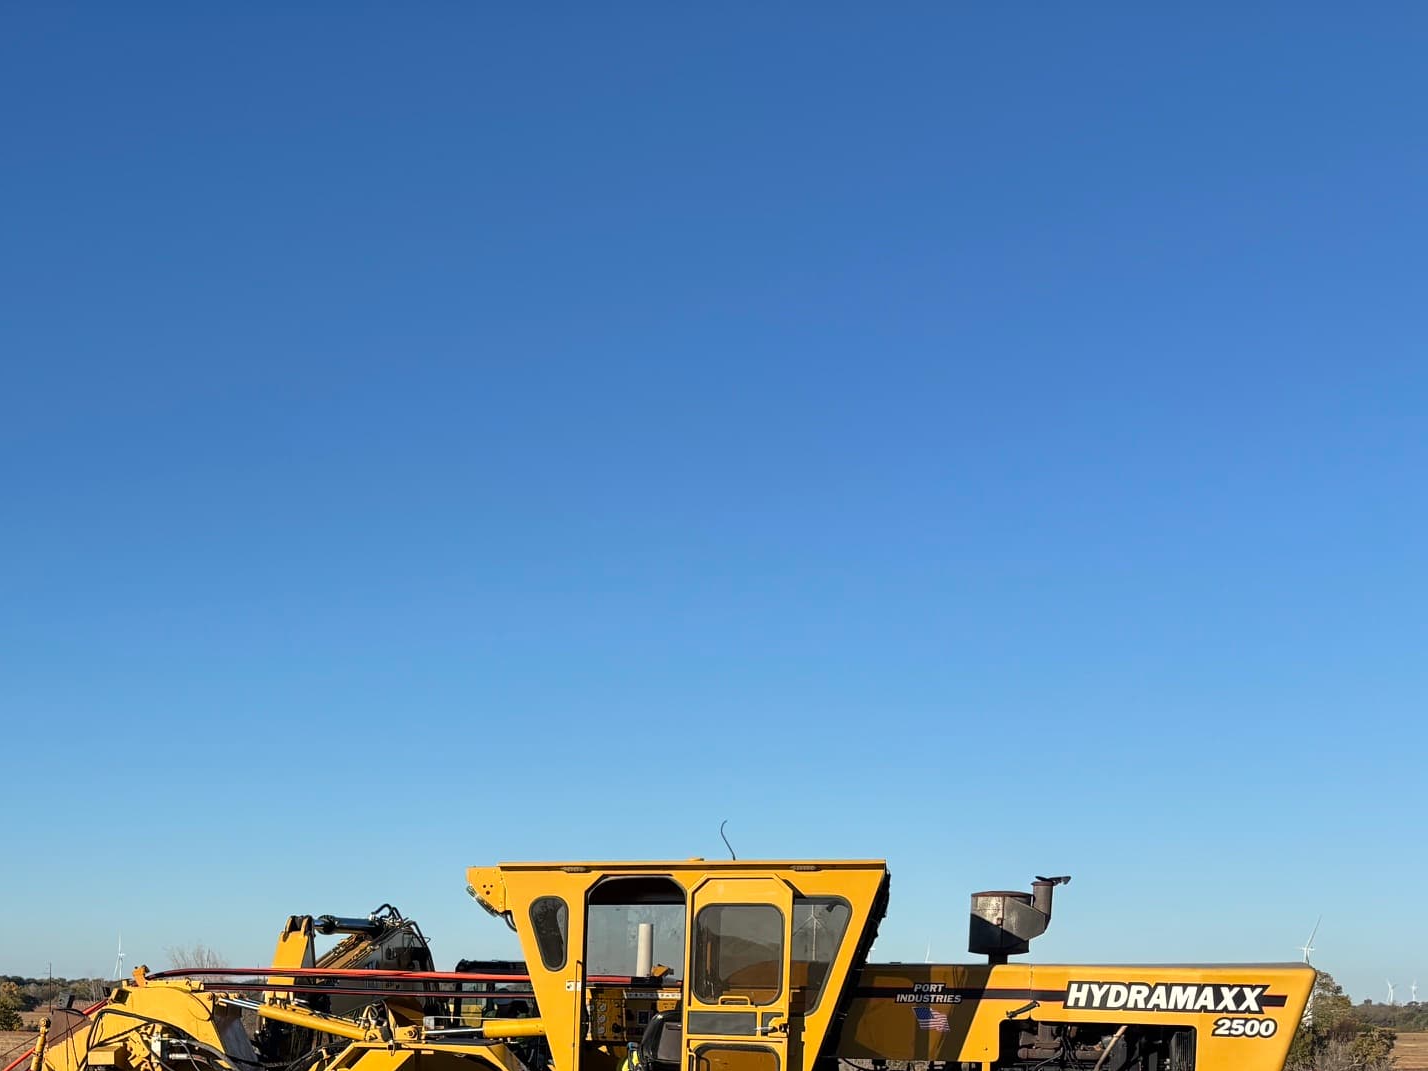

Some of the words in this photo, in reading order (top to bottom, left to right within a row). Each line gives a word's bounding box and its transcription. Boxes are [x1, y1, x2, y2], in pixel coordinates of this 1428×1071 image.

[913, 983, 945, 993] PORT
[896, 993, 962, 1003] INDUSTRIES
[1066, 982, 1264, 1012] HYDRAMAXX
[1213, 1018, 1276, 1036] 2500
